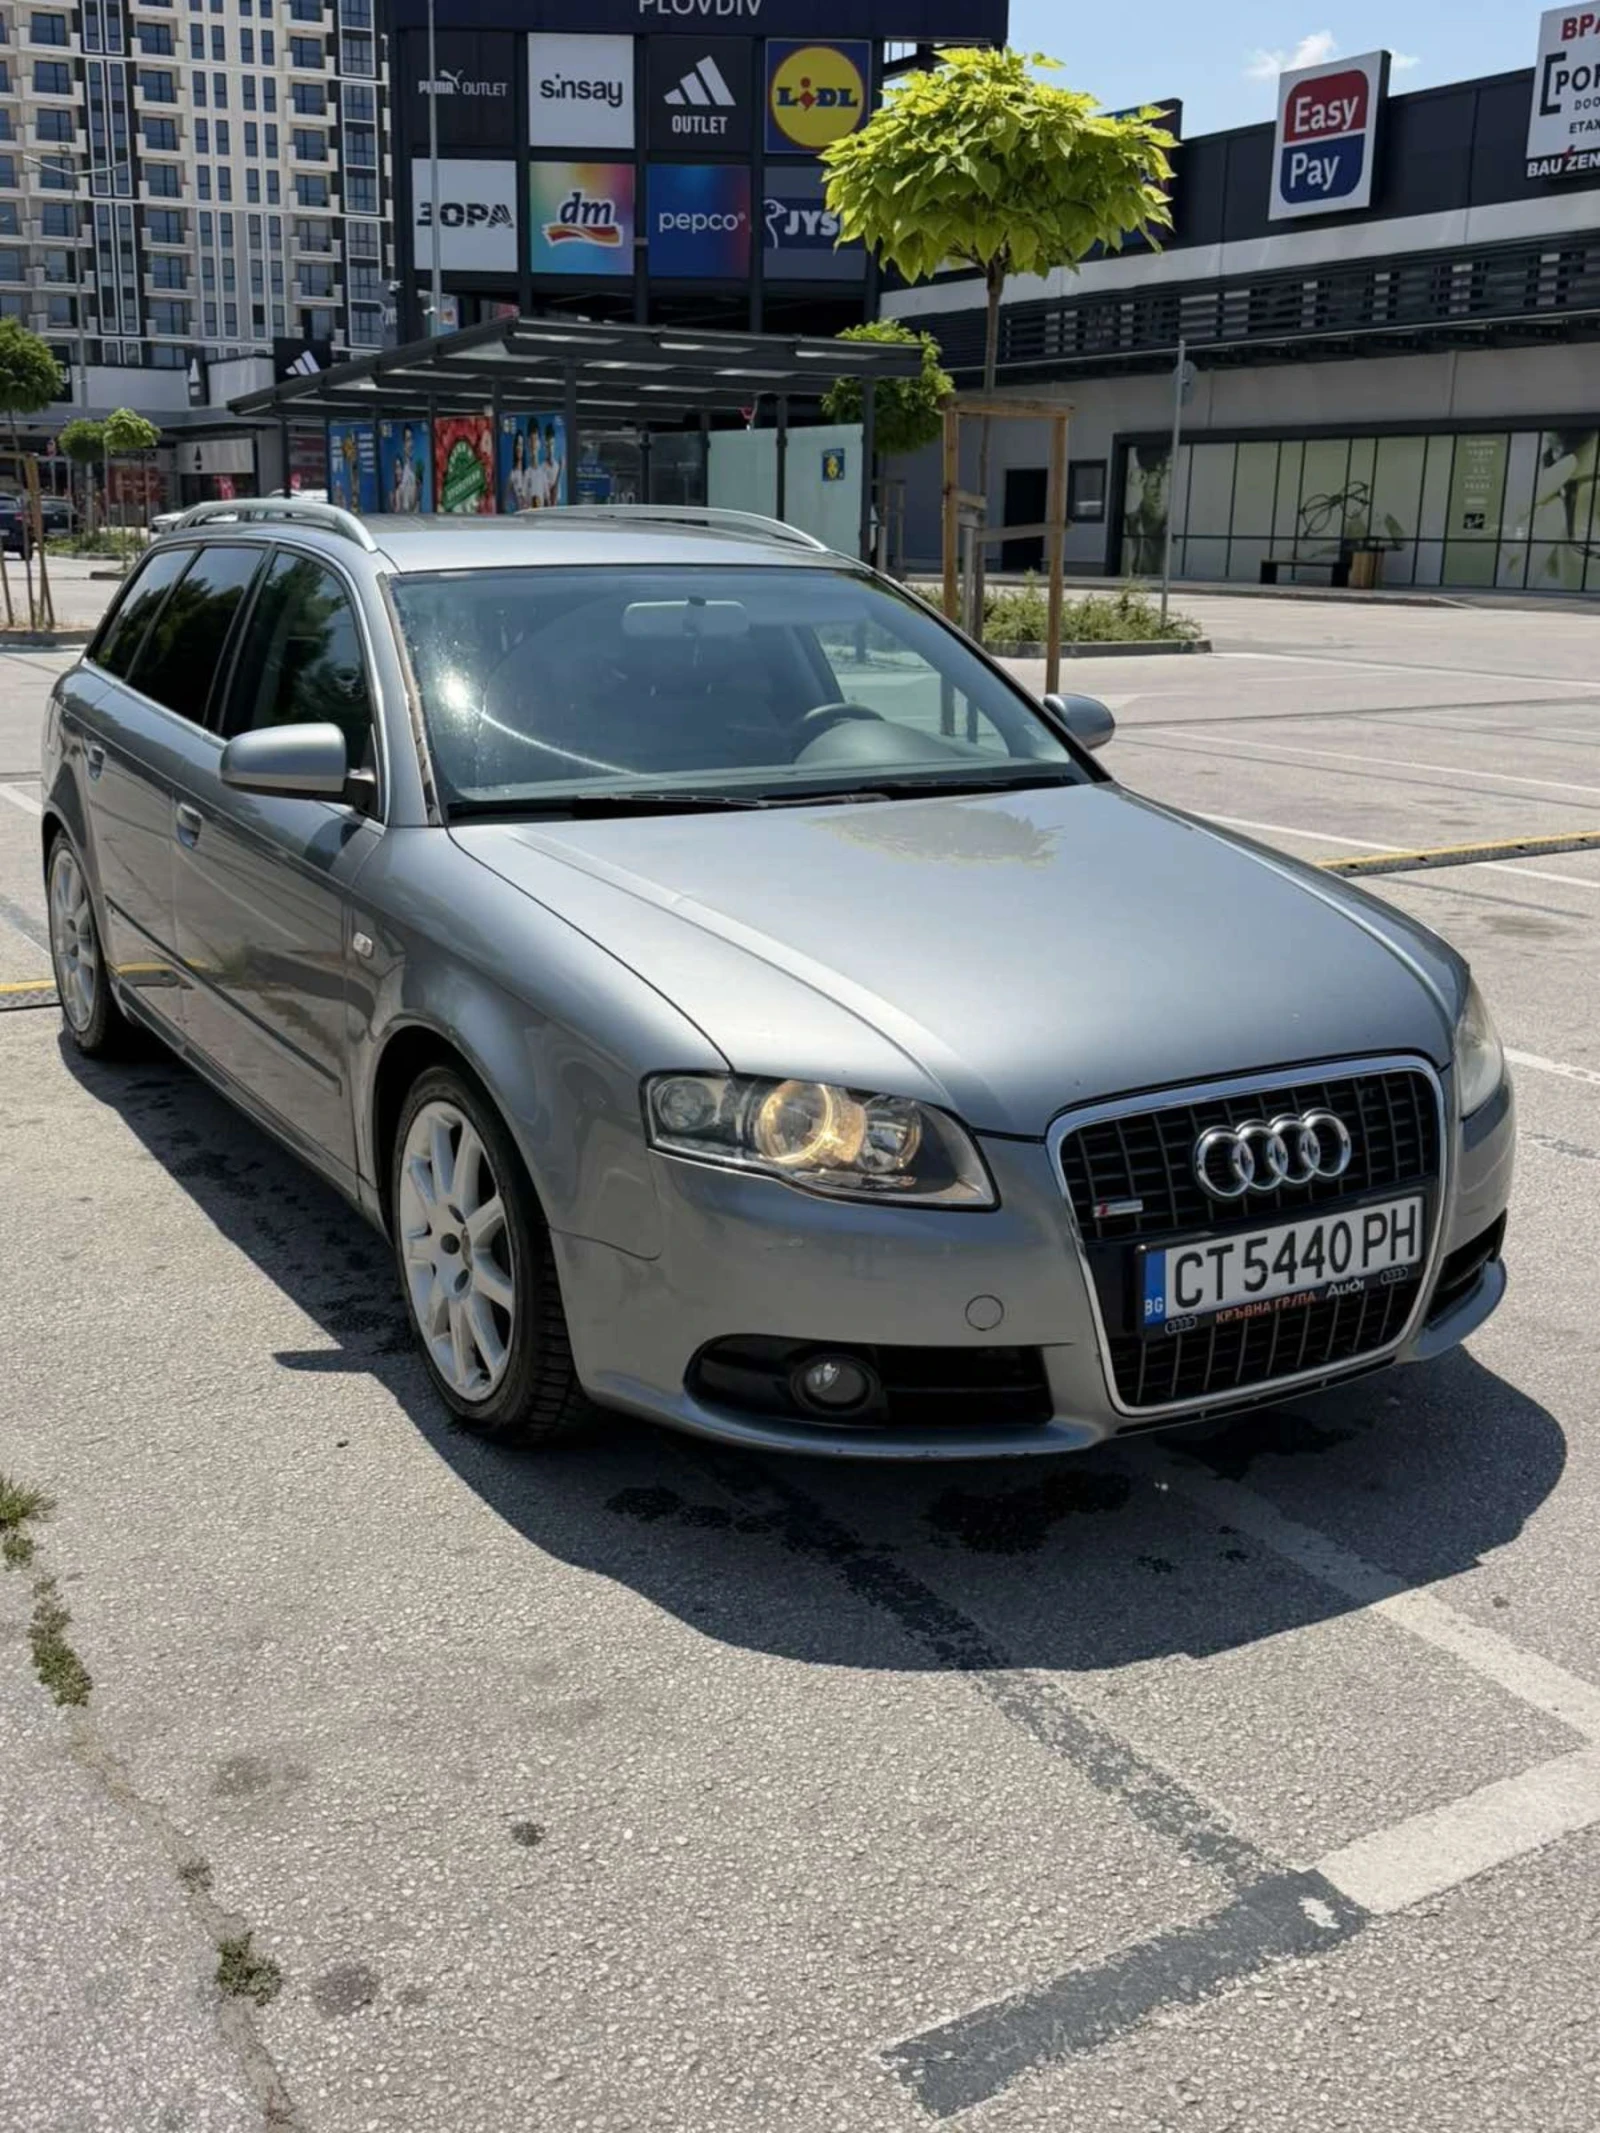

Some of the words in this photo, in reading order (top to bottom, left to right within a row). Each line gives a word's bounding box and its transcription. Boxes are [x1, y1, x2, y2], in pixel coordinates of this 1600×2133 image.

[638, 0, 761, 16] PLOVDIV
[462, 82, 508, 97] OUTLET
[540, 73, 623, 108] sinsay
[672, 115, 727, 134] OUTLET
[1293, 95, 1360, 134] Easy
[1289, 151, 1341, 192] Pay
[559, 192, 612, 225] dm
[784, 210, 844, 236] JYS
[1326, 1277, 1365, 1299] Audi
[1144, 1297, 1164, 1316] BG
